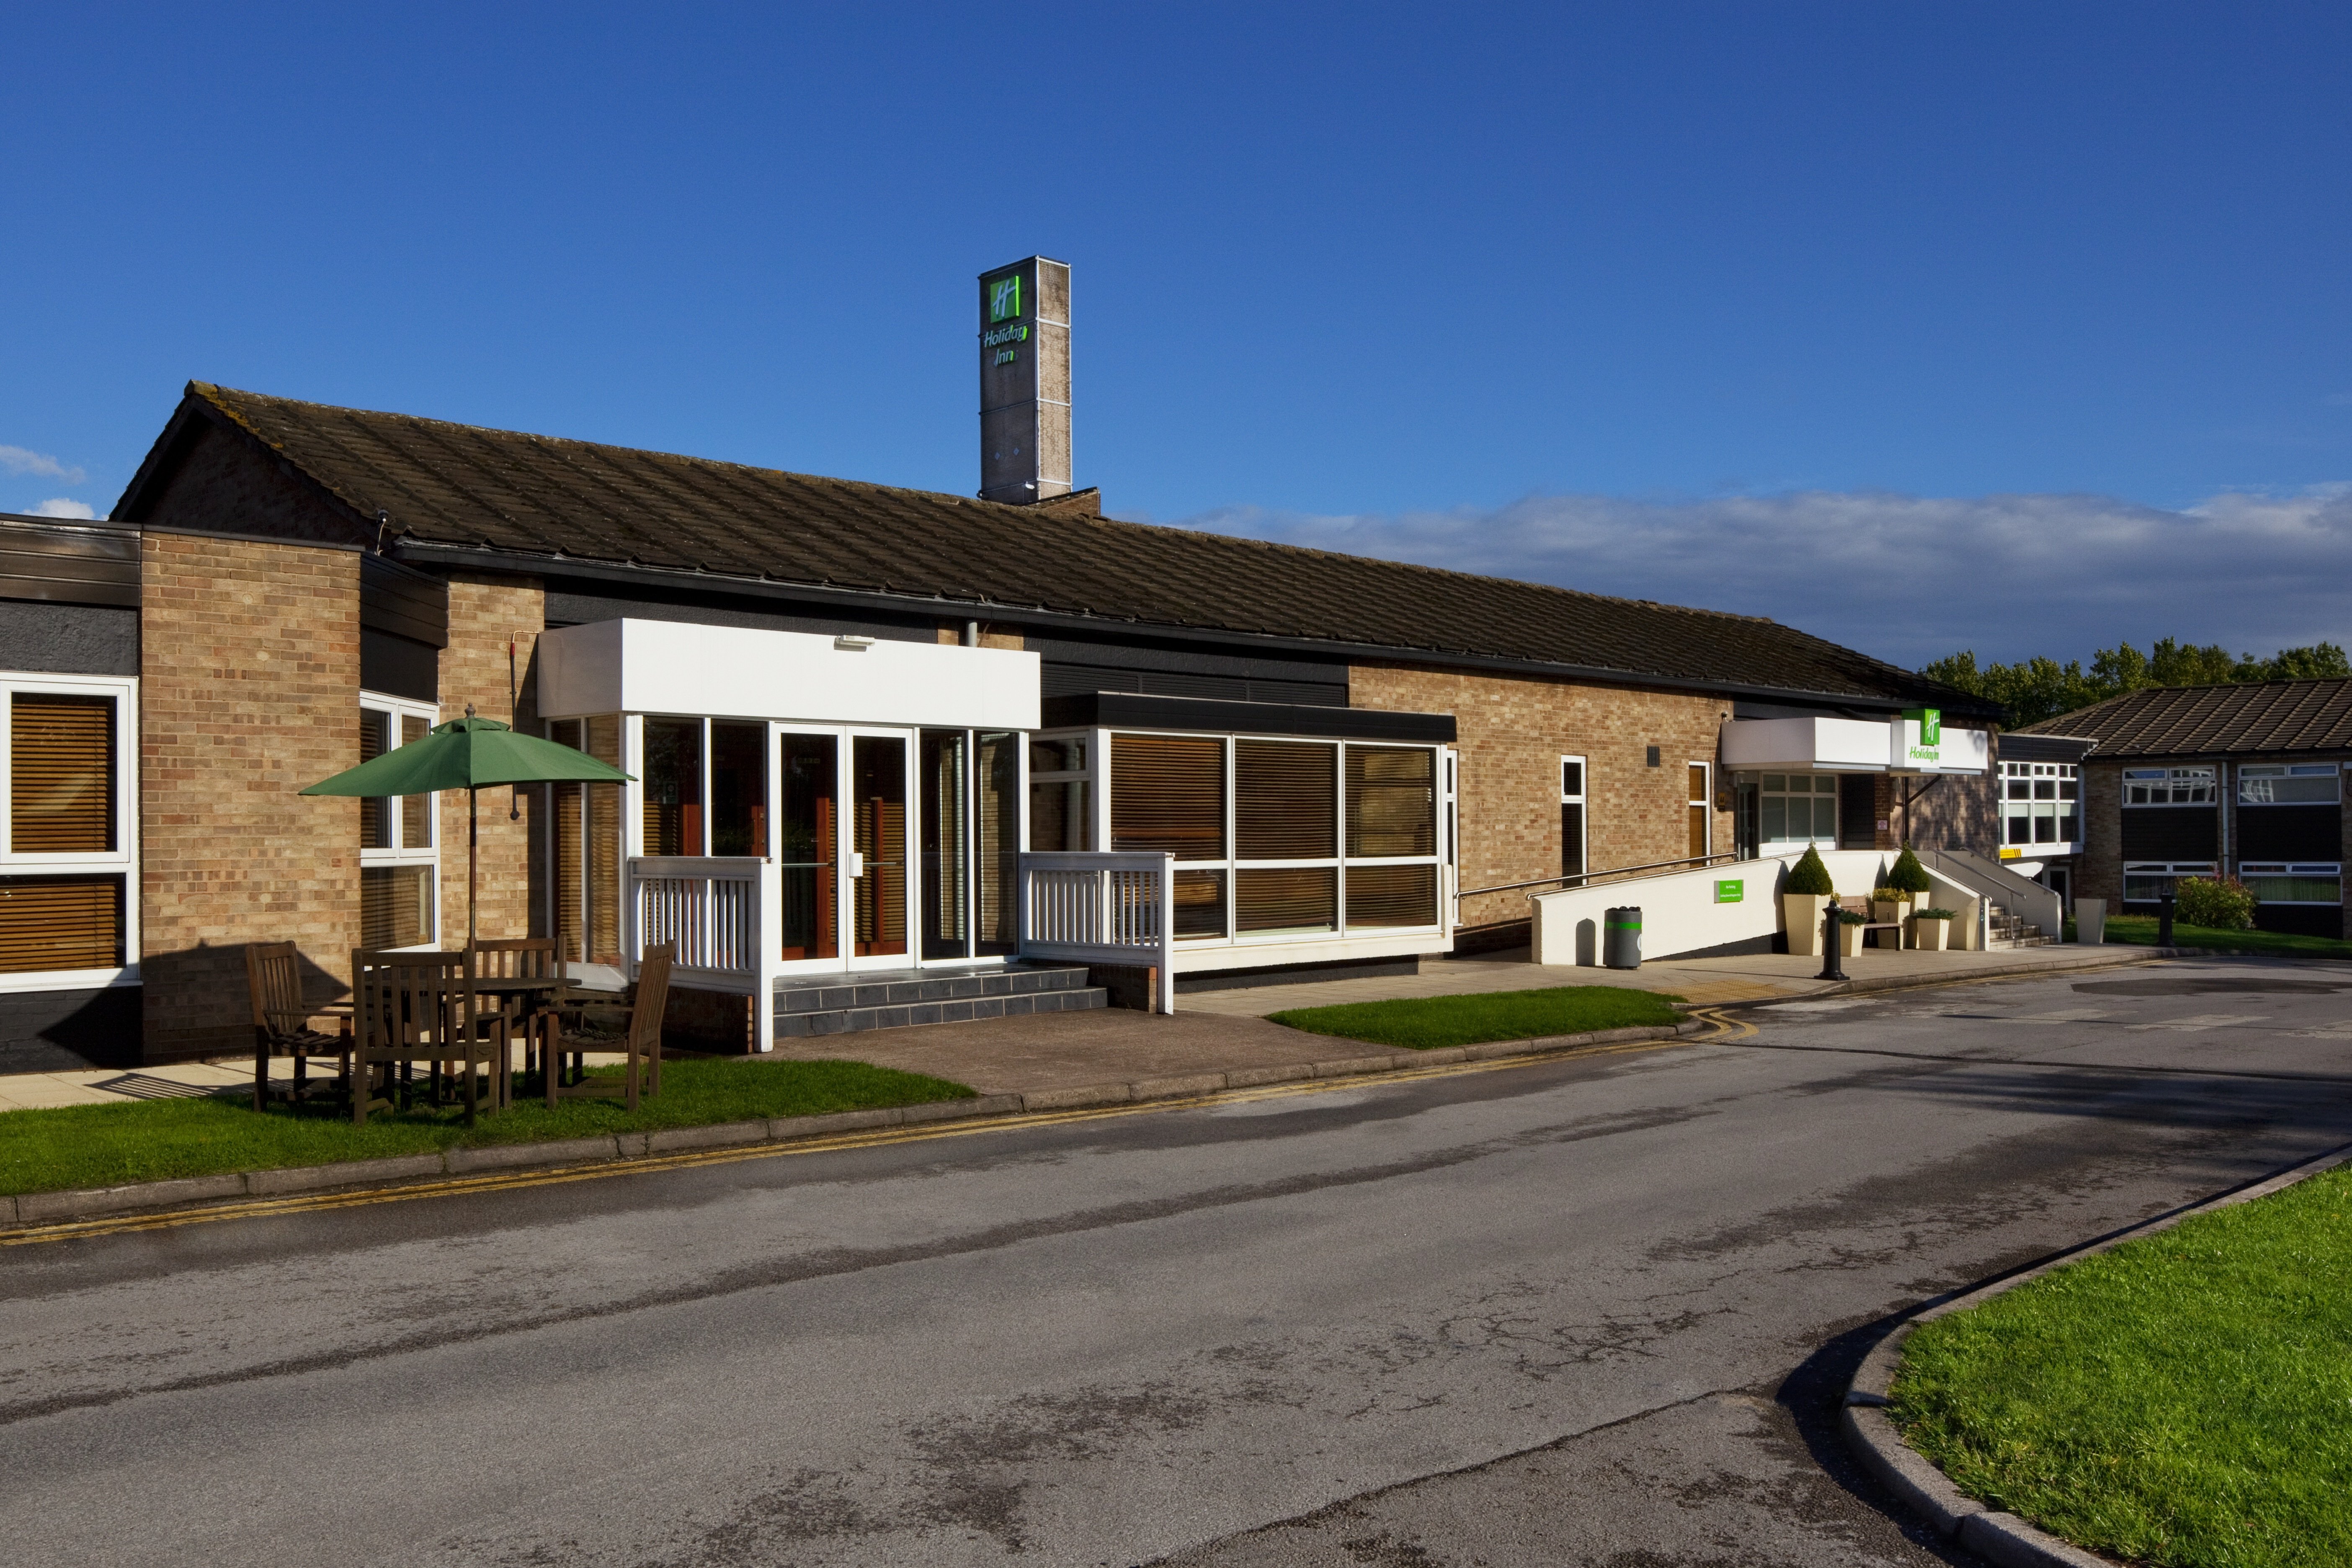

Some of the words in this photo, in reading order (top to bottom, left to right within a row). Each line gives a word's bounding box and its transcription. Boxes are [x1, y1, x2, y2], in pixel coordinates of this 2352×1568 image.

[984, 325, 1027, 348] Holiday
[996, 348, 1014, 365] Inn
[1909, 746, 1934, 763] Holiday
